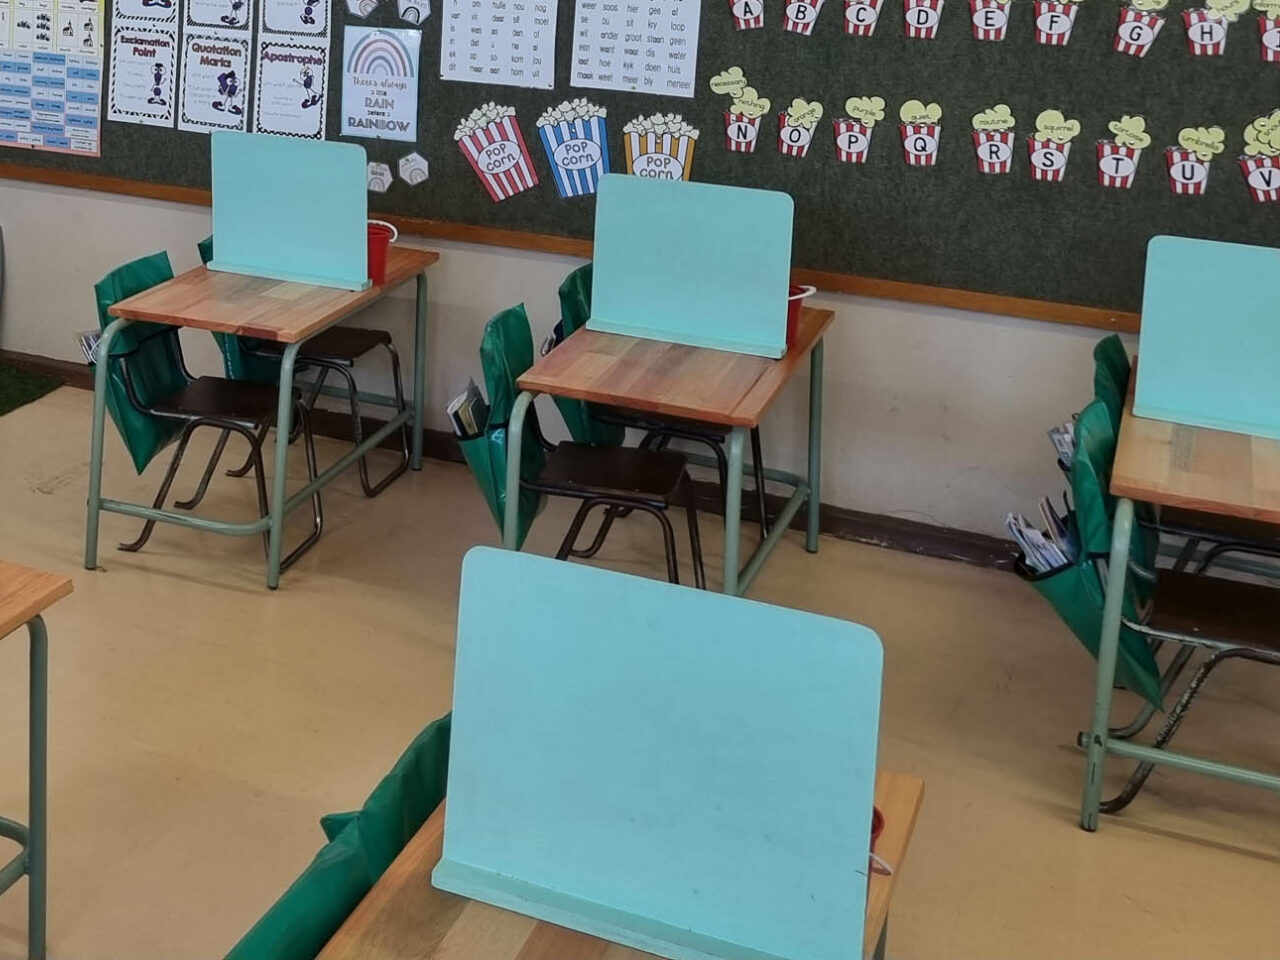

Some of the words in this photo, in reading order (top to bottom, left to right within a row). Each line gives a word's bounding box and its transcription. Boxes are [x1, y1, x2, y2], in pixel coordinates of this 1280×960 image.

[743, 1, 754, 17] A
[795, 4, 807, 20] B
[855, 7, 866, 23] C
[916, 8, 929, 25] D
[984, 10, 996, 27] E
[1048, 15, 1061, 31] F
[1129, 25, 1144, 41] G
[1200, 24, 1213, 41] H
[120, 36, 170, 48] Exclamation
[191, 43, 242, 57] Quotation
[132, 47, 157, 58] Point
[263, 50, 323, 66] Apostrophe
[200, 56, 231, 68] Marks
[365, 97, 395, 109] RAIN
[852, 105, 877, 117] purple
[348, 117, 410, 133] RAINBOW
[737, 125, 748, 140] N
[789, 128, 801, 143] O
[847, 134, 859, 150] P
[913, 137, 927, 153] Q
[989, 144, 1000, 160] R
[486, 155, 516, 172] corn
[561, 152, 594, 166] corn
[1041, 151, 1054, 168] S
[1111, 157, 1124, 174] T
[639, 167, 674, 180] corn
[1181, 164, 1194, 180] U
[1259, 170, 1272, 188] V
